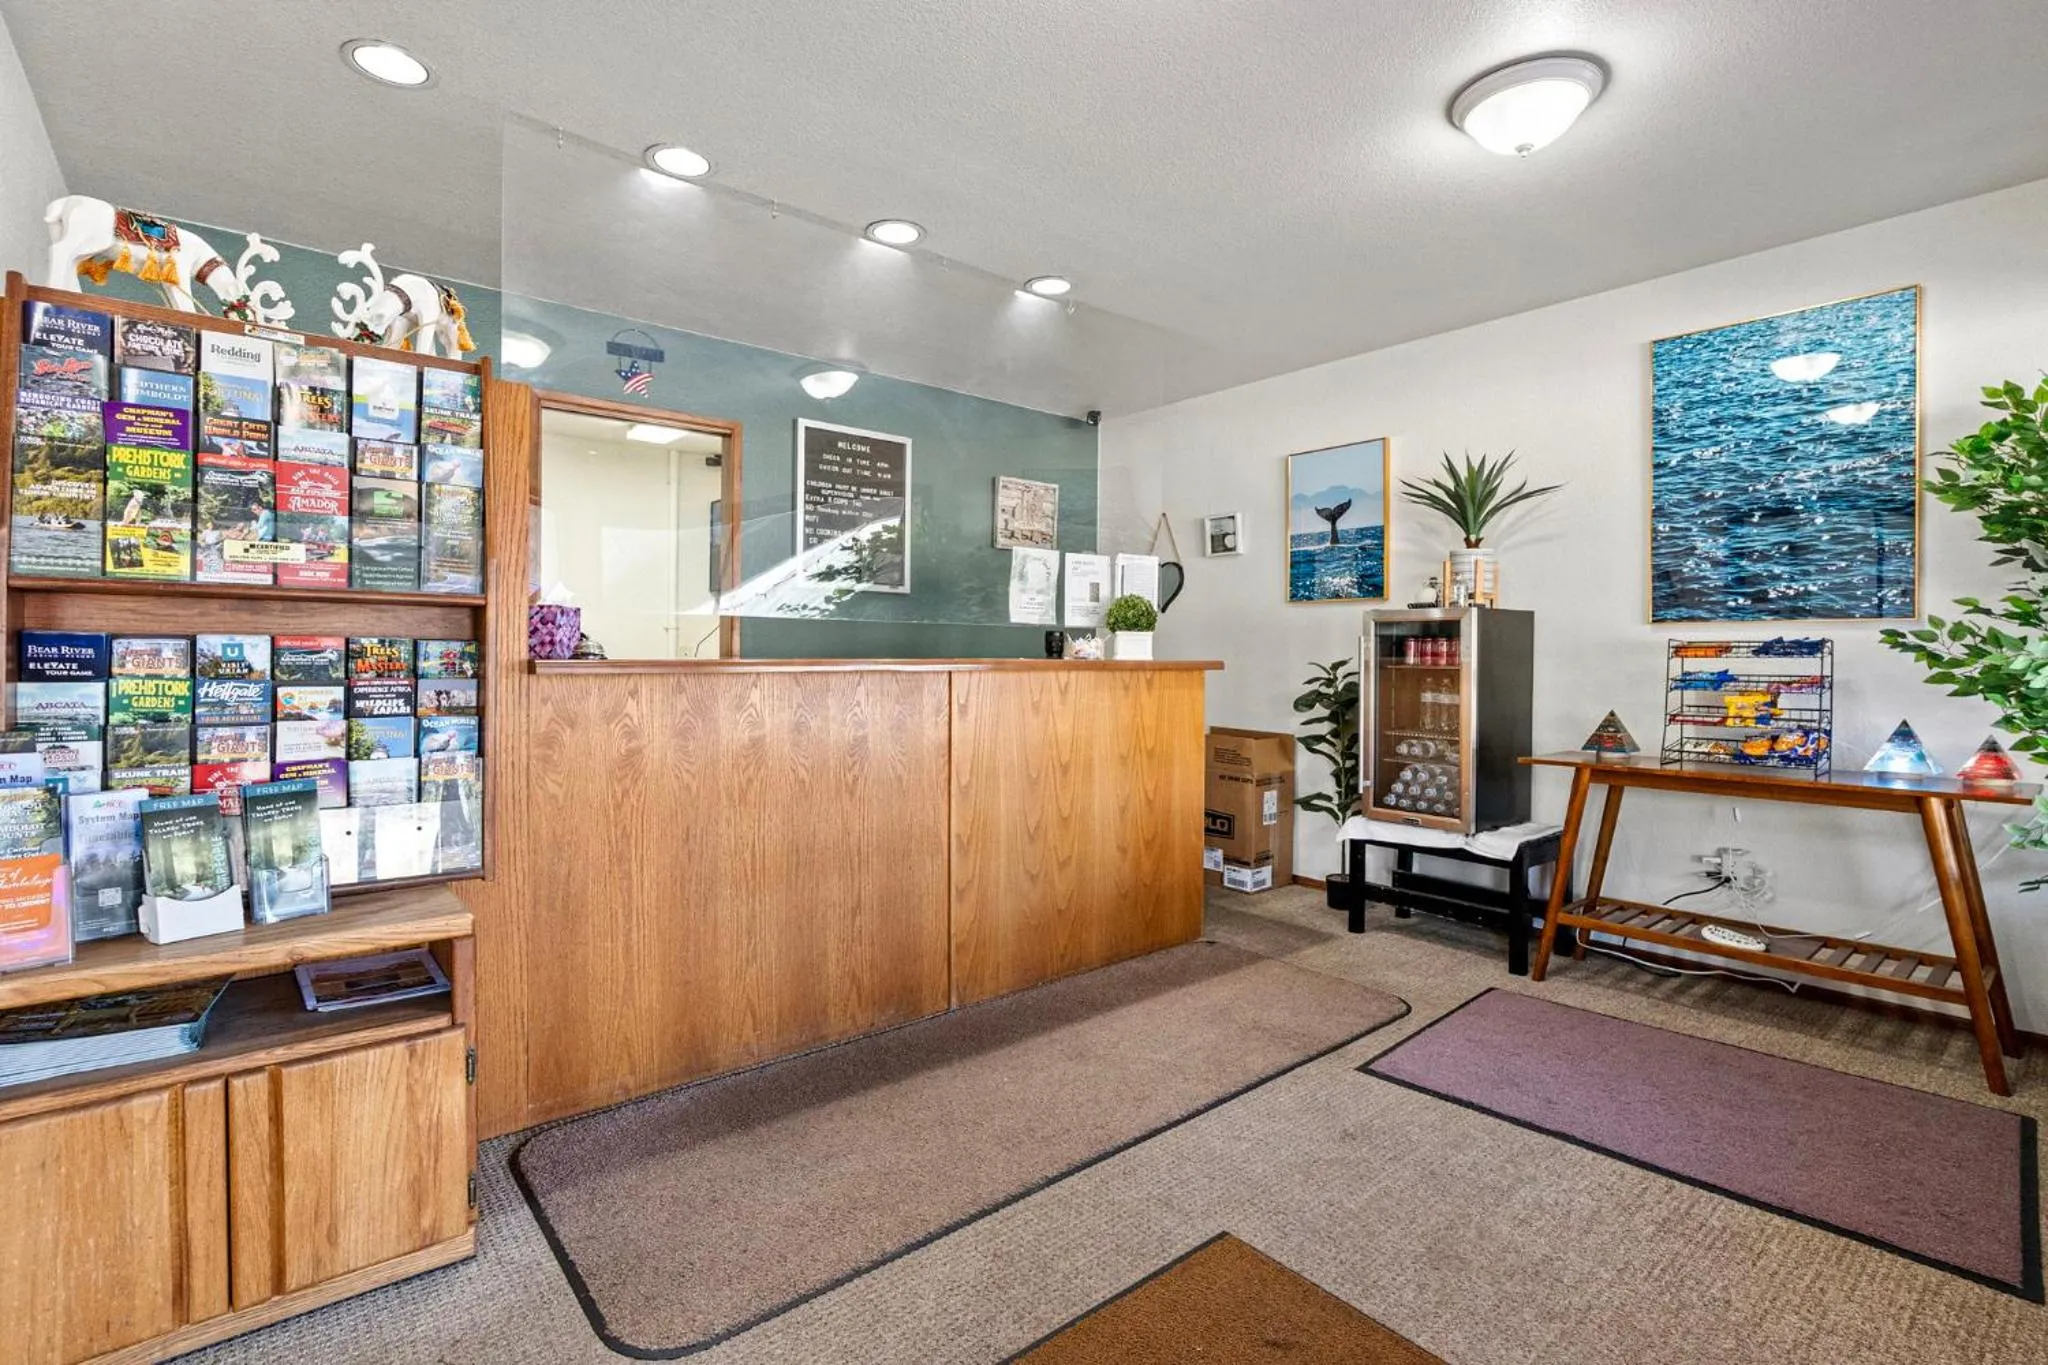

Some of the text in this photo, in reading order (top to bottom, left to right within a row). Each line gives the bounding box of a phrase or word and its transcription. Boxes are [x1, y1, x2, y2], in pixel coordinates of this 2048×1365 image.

[67, 318, 101, 332] RIVER
[34, 331, 85, 346] ELEVATE
[210, 342, 262, 363] Redding
[123, 407, 174, 418] CHAPMAN'S
[115, 413, 136, 421] GEM
[142, 416, 182, 426] MINERAL
[125, 426, 173, 437] MUSEUM
[838, 441, 871, 454] WELCOME
[125, 464, 172, 480] GARDENS
[288, 496, 343, 516] AMADOR
[27, 644, 96, 656] BEAR RIVER
[364, 643, 401, 657] TREES
[28, 661, 79, 670] ELEVATE
[356, 659, 409, 673] MYSTERY
[198, 681, 264, 703] Hellgate
[353, 686, 388, 694] EXPERIENCE
[35, 701, 88, 711] ARCATA
[131, 695, 175, 709] GARDENS
[355, 698, 406, 709] WILDLIFE
[373, 705, 411, 715] SAFARI
[422, 719, 450, 728] OCEAN
[113, 768, 190, 779] SKUNK TRAIN
[285, 763, 329, 773] CHAPMAN'S
[10, 774, 33, 784] Map
[256, 783, 304, 795] FREE MAP
[153, 798, 205, 811] FREE MAP
[78, 812, 139, 826] System Map
